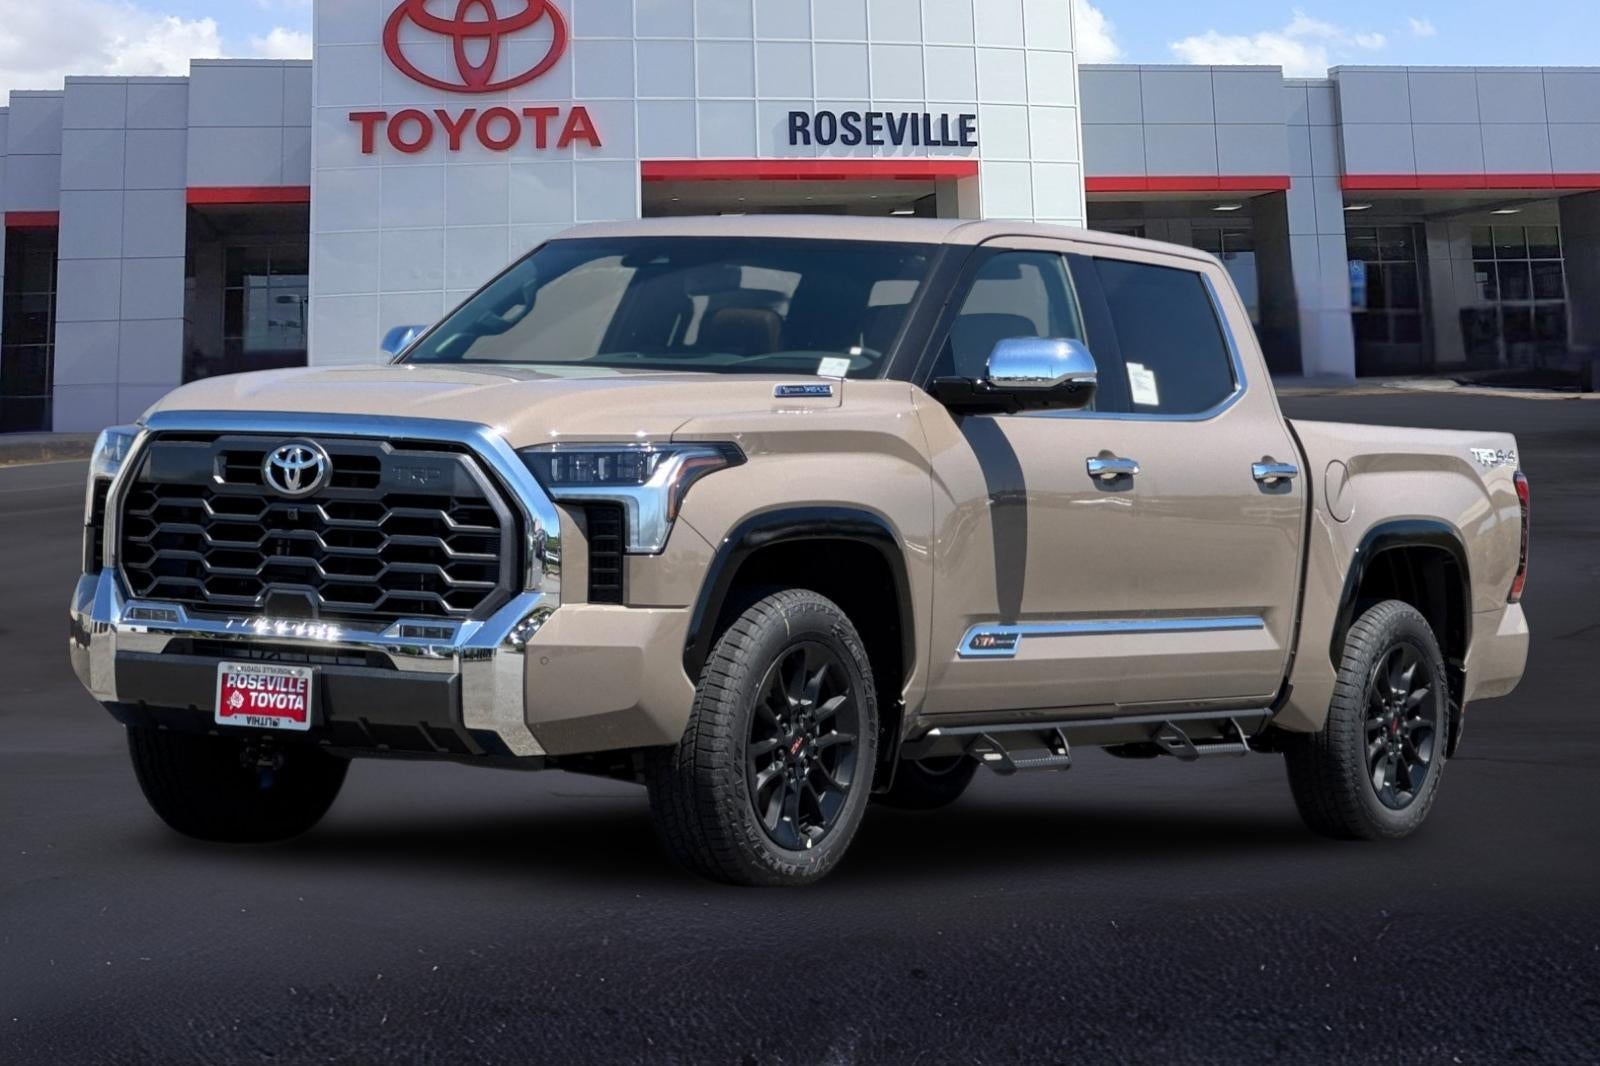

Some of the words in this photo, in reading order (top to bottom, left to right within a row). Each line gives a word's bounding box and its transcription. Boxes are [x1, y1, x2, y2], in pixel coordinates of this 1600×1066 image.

[349, 106, 602, 153] TOYOTA
[788, 110, 978, 147] ROSEVILLE
[227, 673, 305, 693] ROSEVILLE
[249, 692, 304, 711] TOYOTA
[246, 715, 272, 727] LITHIA
